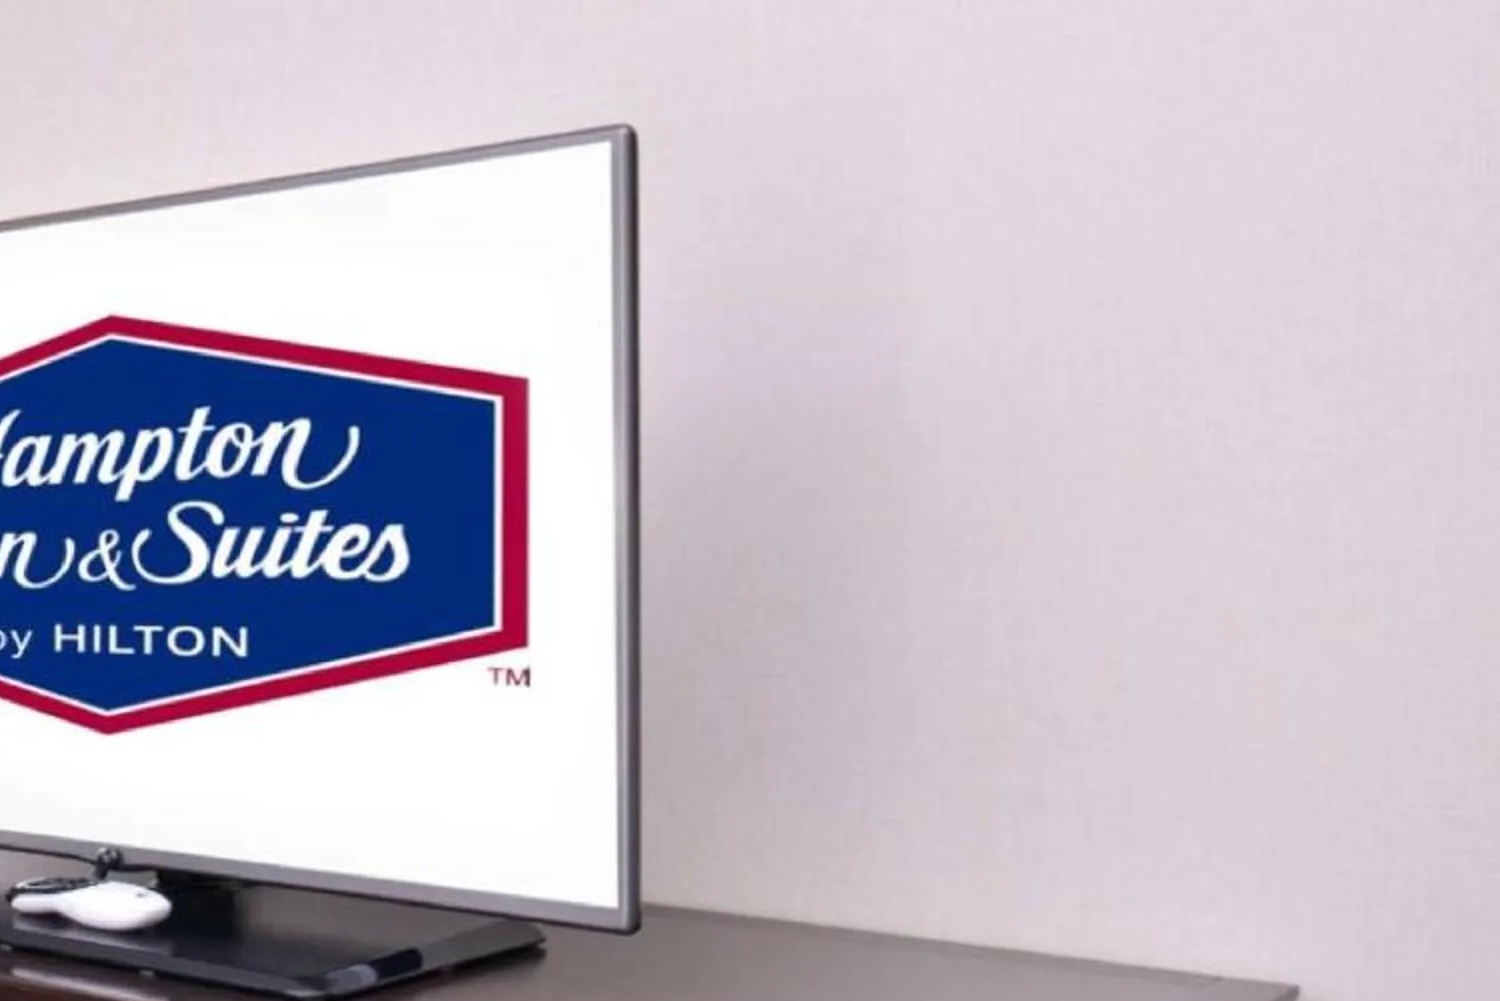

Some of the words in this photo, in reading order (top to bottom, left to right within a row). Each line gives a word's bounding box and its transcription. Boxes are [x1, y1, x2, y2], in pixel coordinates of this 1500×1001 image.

[78, 529, 136, 591] &
[131, 500, 410, 585] Suites
[54, 623, 249, 658] HILTON
[488, 666, 532, 688] TM
